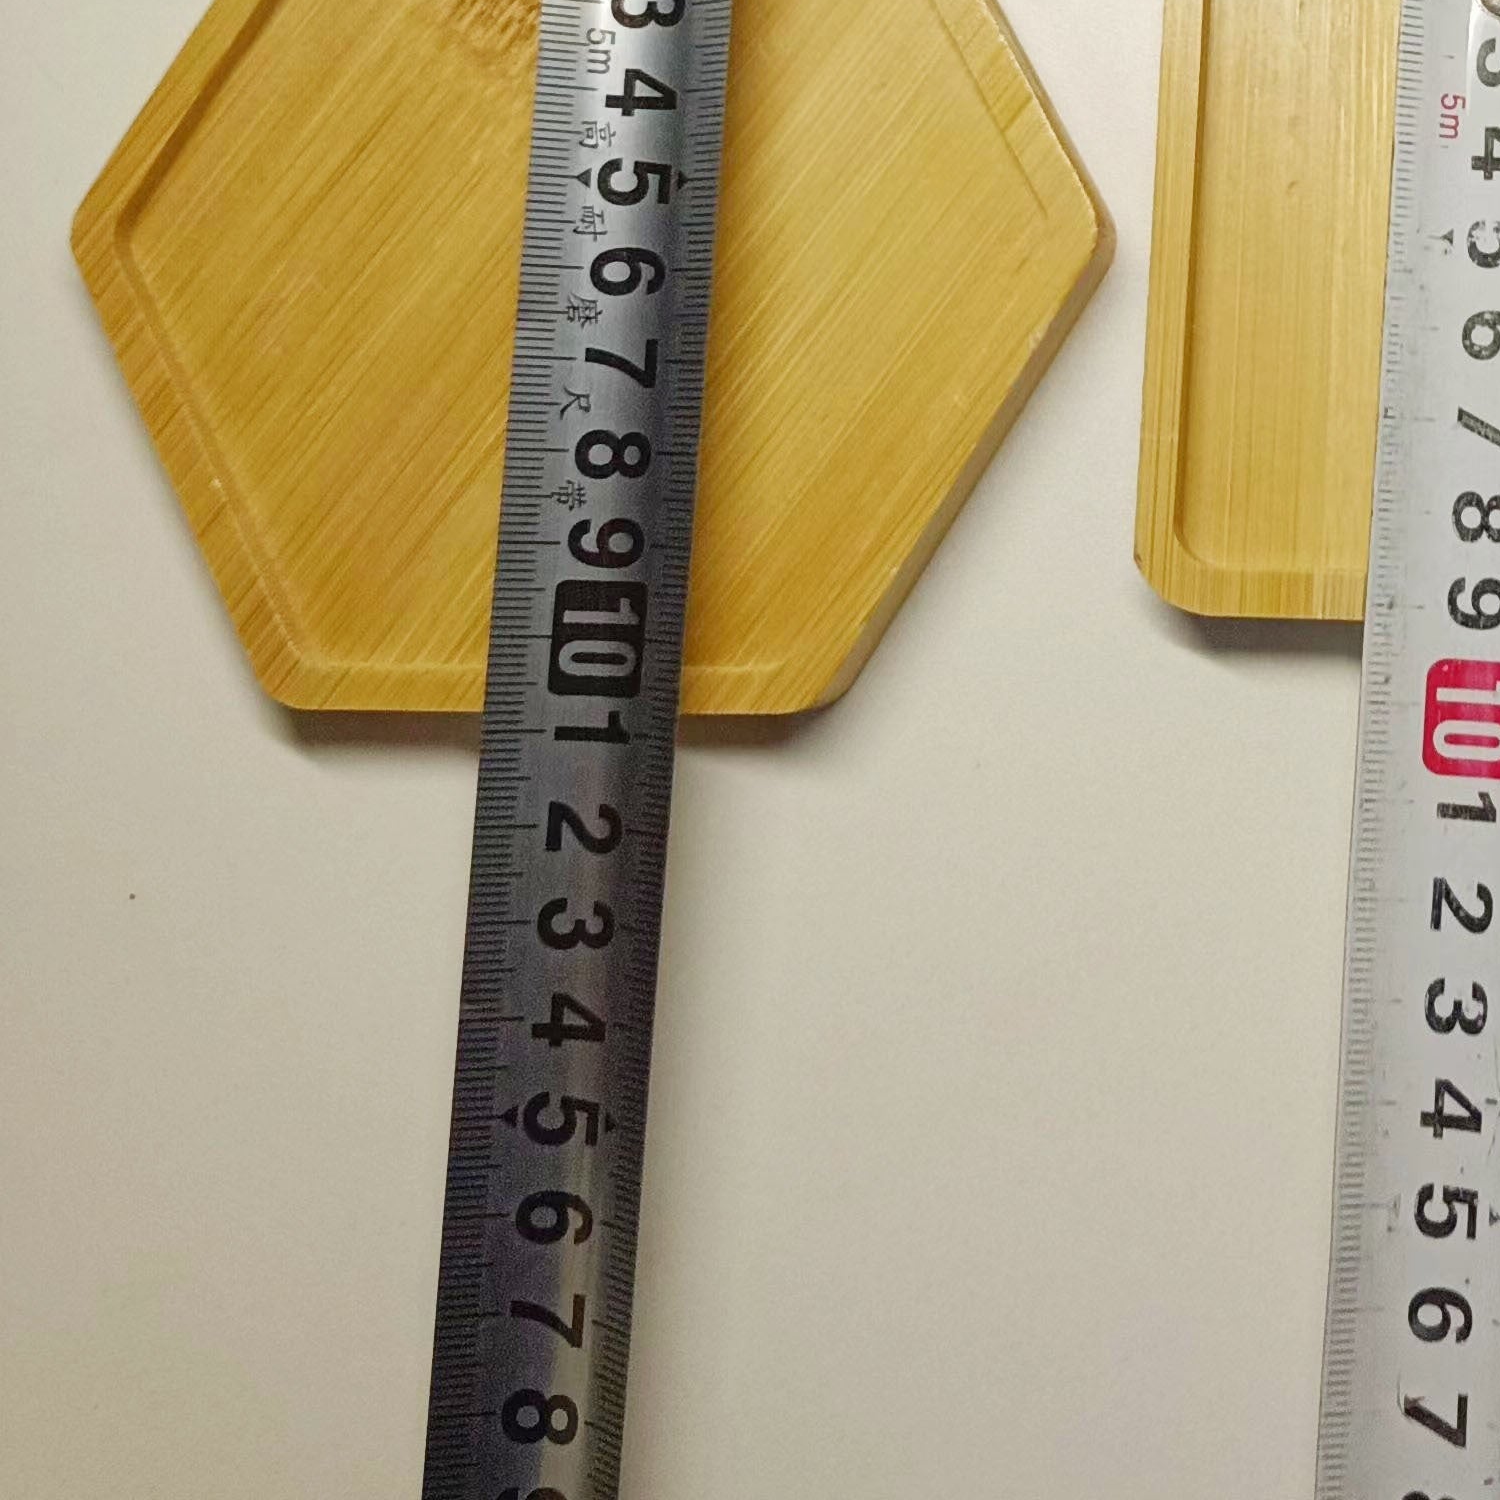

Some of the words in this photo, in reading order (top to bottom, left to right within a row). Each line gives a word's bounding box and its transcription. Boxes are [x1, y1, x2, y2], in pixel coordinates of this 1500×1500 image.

[585, 27, 616, 75] 5m
[605, 68, 678, 117] 4
[1439, 92, 1466, 140] 5m
[597, 157, 671, 206] 5
[590, 247, 665, 296] 6
[585, 339, 658, 389] 7
[575, 429, 651, 479] 8
[568, 517, 645, 569] 9
[557, 596, 642, 678] 10
[554, 711, 630, 744] 1
[545, 801, 623, 852] 2
[1436, 791, 1497, 823] 1
[537, 898, 615, 950] 3
[1430, 877, 1493, 935] 2
[531, 993, 606, 1048] 4
[1424, 977, 1488, 1035] 3
[523, 1091, 599, 1147] 5
[1420, 1078, 1483, 1139] 4
[515, 1190, 593, 1245] 6
[1414, 1182, 1478, 1240] 5
[510, 1294, 586, 1348] 7
[1408, 1287, 1473, 1343] 6
[501, 1388, 579, 1445] 8
[1404, 1393, 1468, 1448] 7
